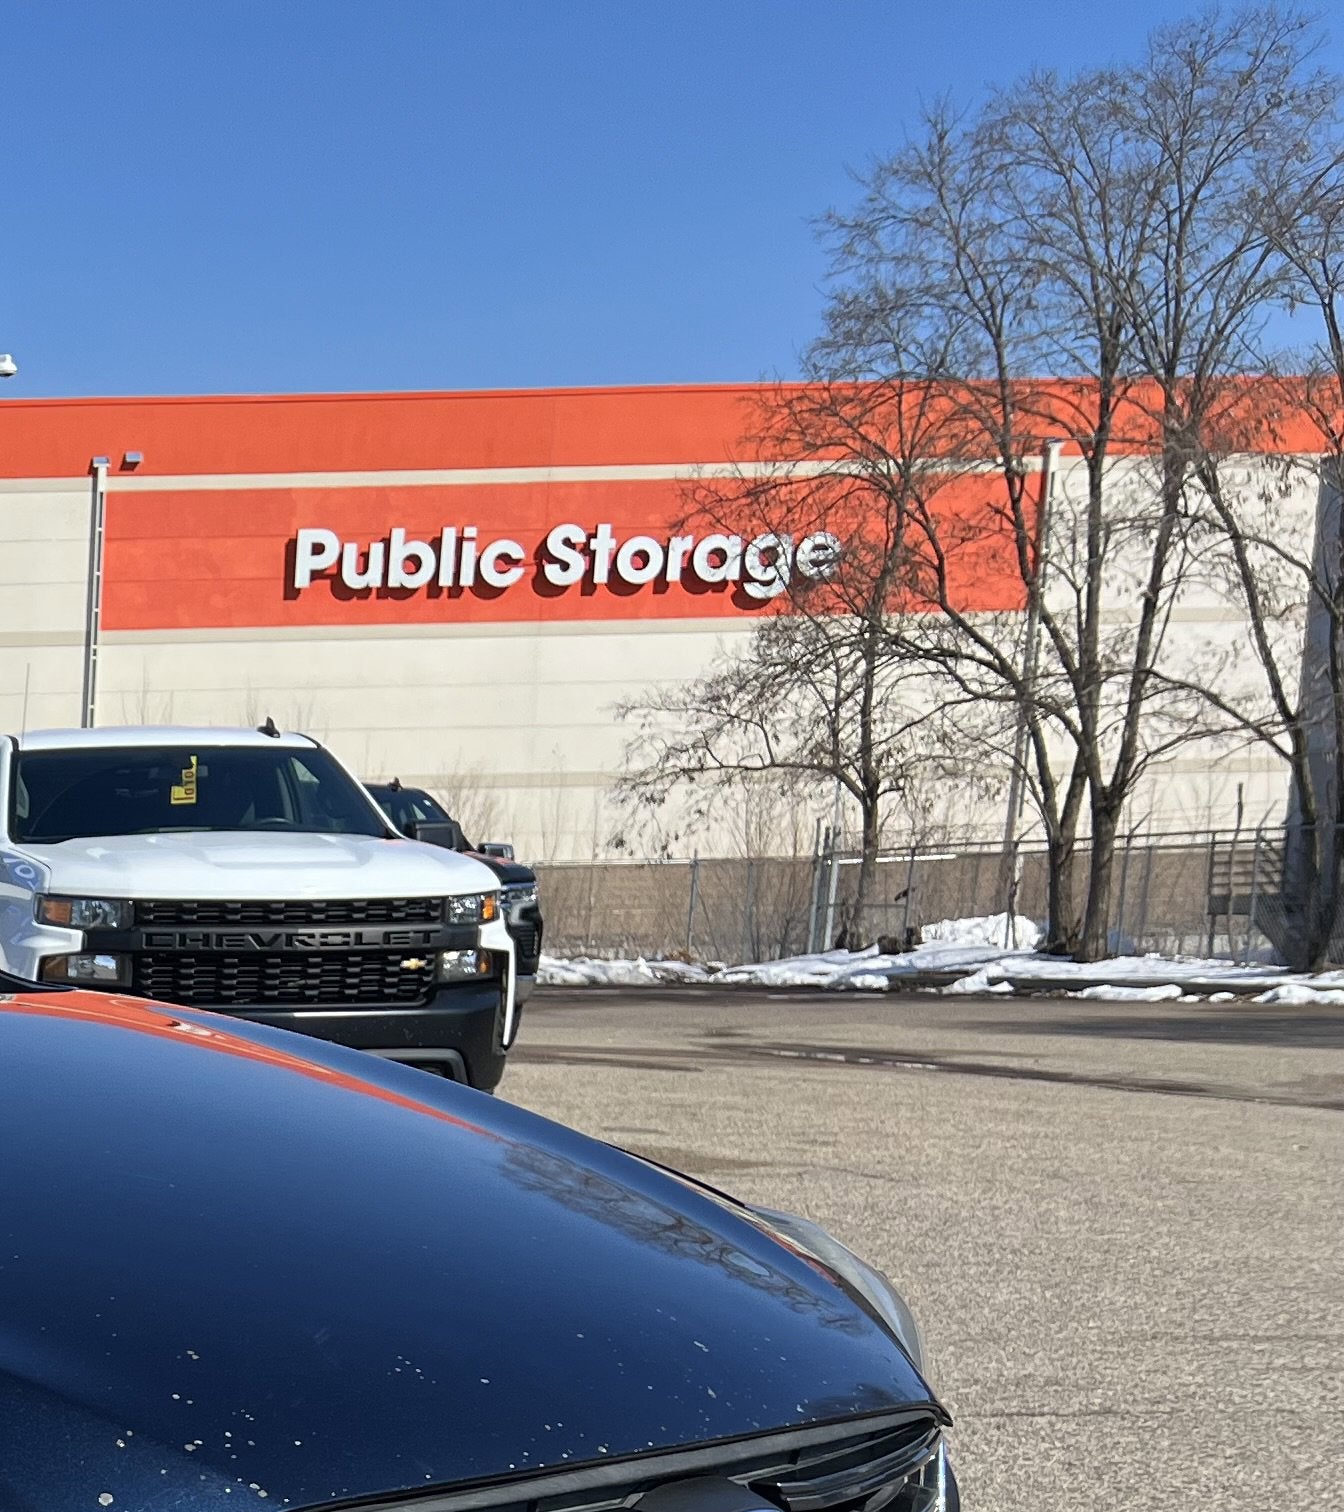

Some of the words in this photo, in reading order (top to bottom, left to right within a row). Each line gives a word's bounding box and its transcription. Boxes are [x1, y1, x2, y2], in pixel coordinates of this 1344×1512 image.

[292, 525, 526, 591] Public
[543, 522, 842, 600] Storage
[142, 929, 441, 950] CHEVROLET
